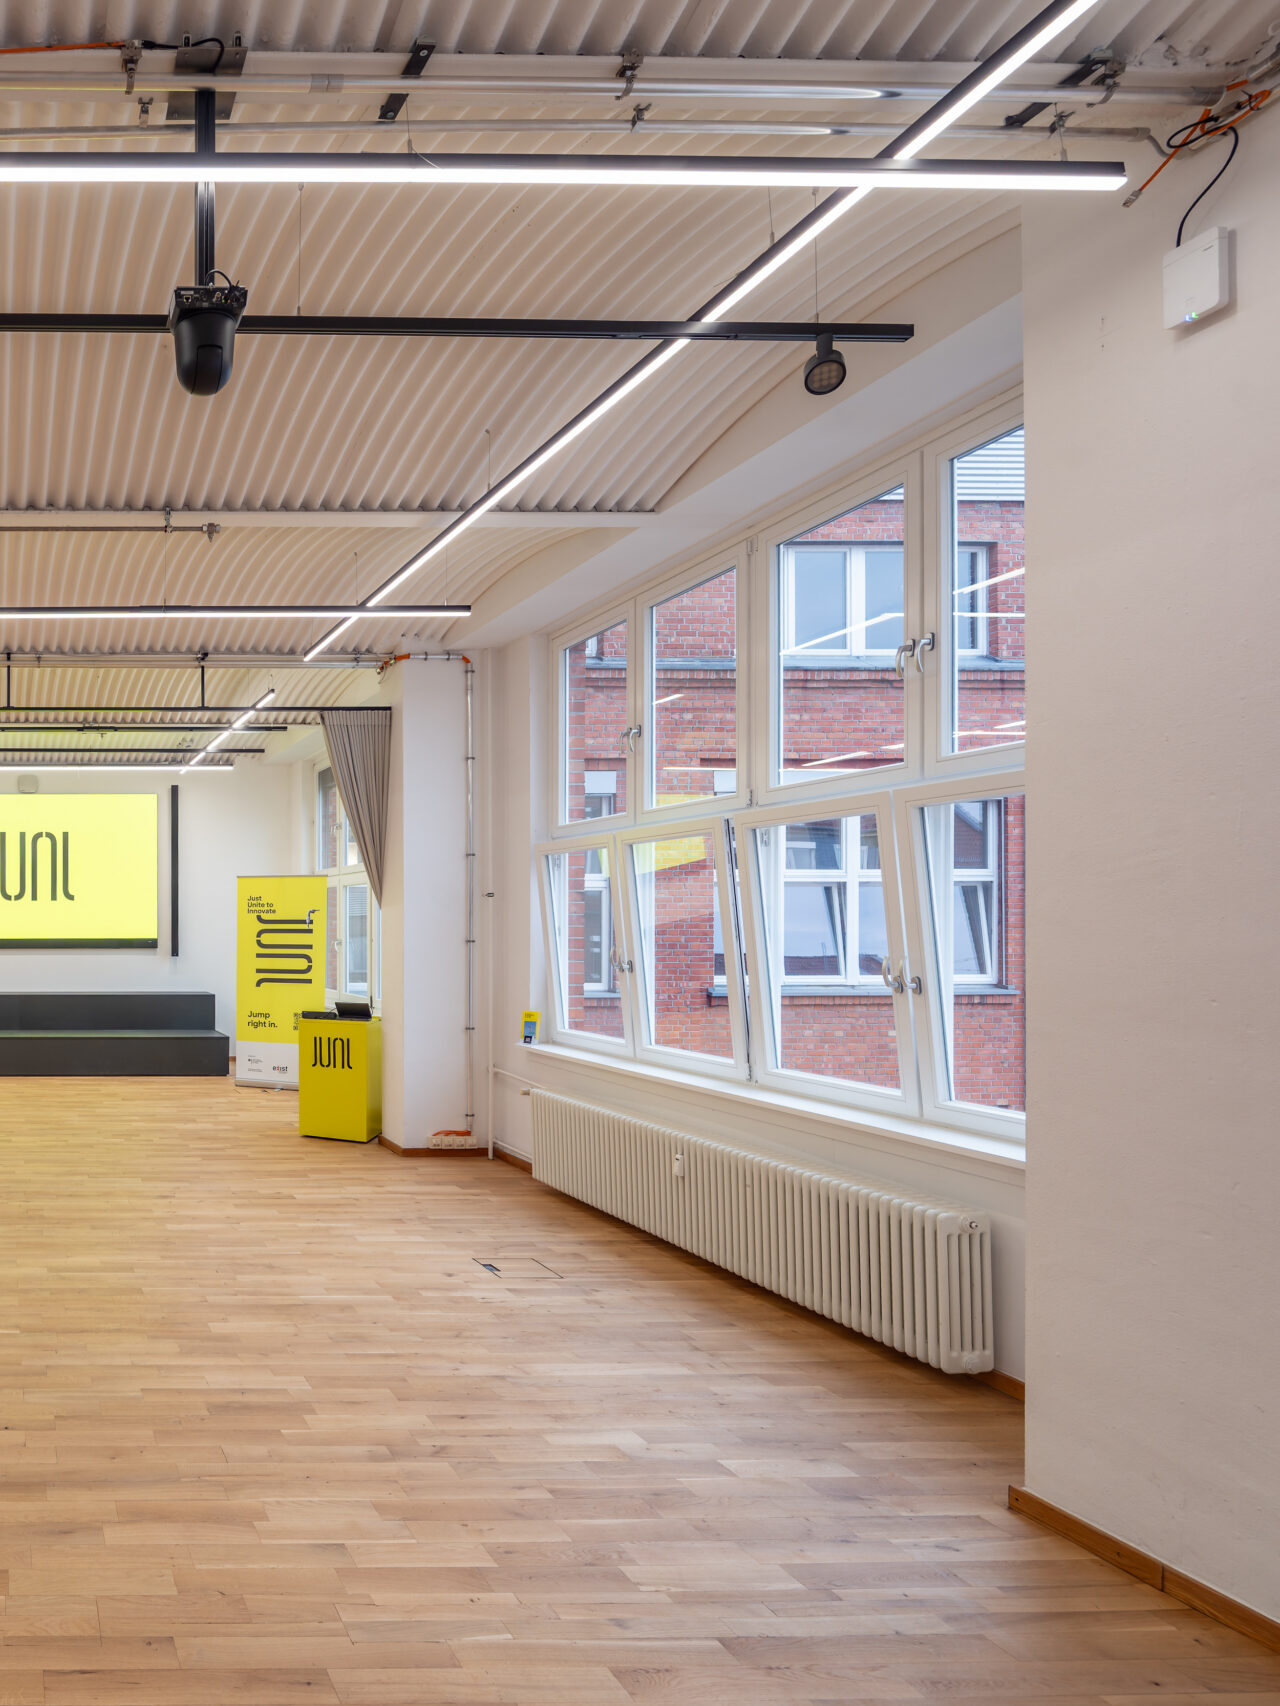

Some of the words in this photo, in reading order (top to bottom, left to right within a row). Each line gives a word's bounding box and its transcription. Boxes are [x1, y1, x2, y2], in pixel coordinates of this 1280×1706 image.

[247, 1011, 270, 1019] Jump
[247, 1020, 266, 1028] right
[268, 1020, 278, 1028] in.
